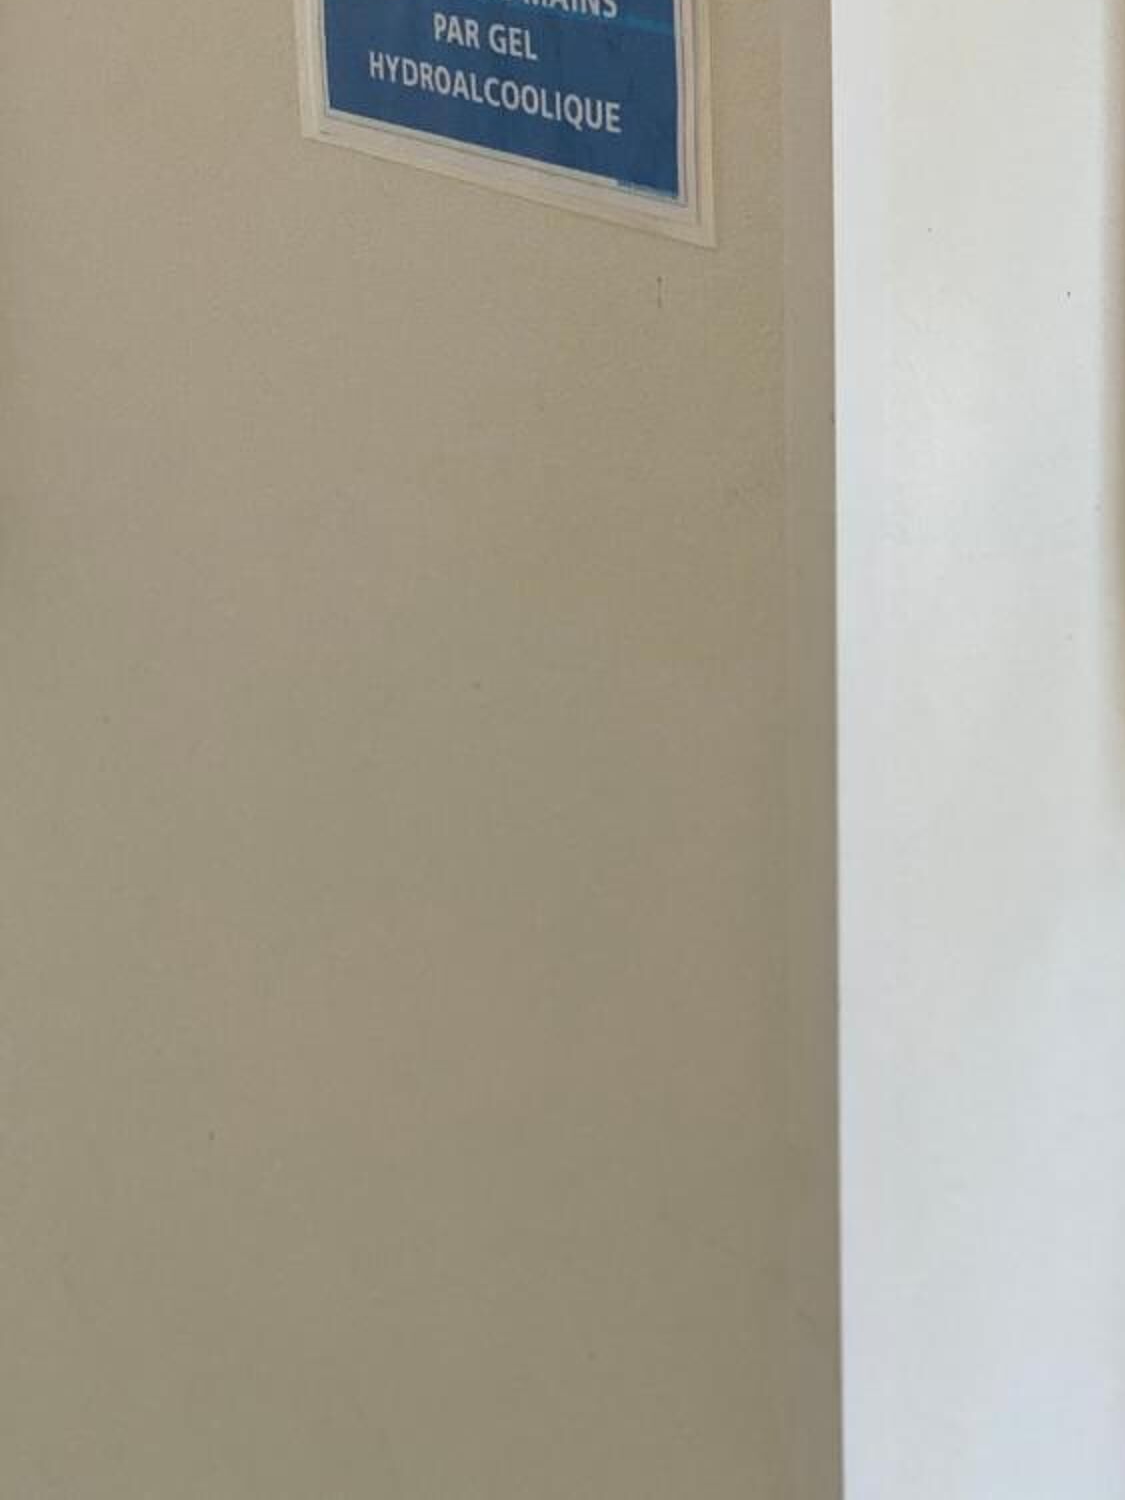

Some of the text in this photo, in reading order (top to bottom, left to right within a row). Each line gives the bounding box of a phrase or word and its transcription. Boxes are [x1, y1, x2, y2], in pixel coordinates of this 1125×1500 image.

[433, 12, 537, 60] PAR GEL
[369, 51, 622, 134] HYDROALCOOLIQUE
